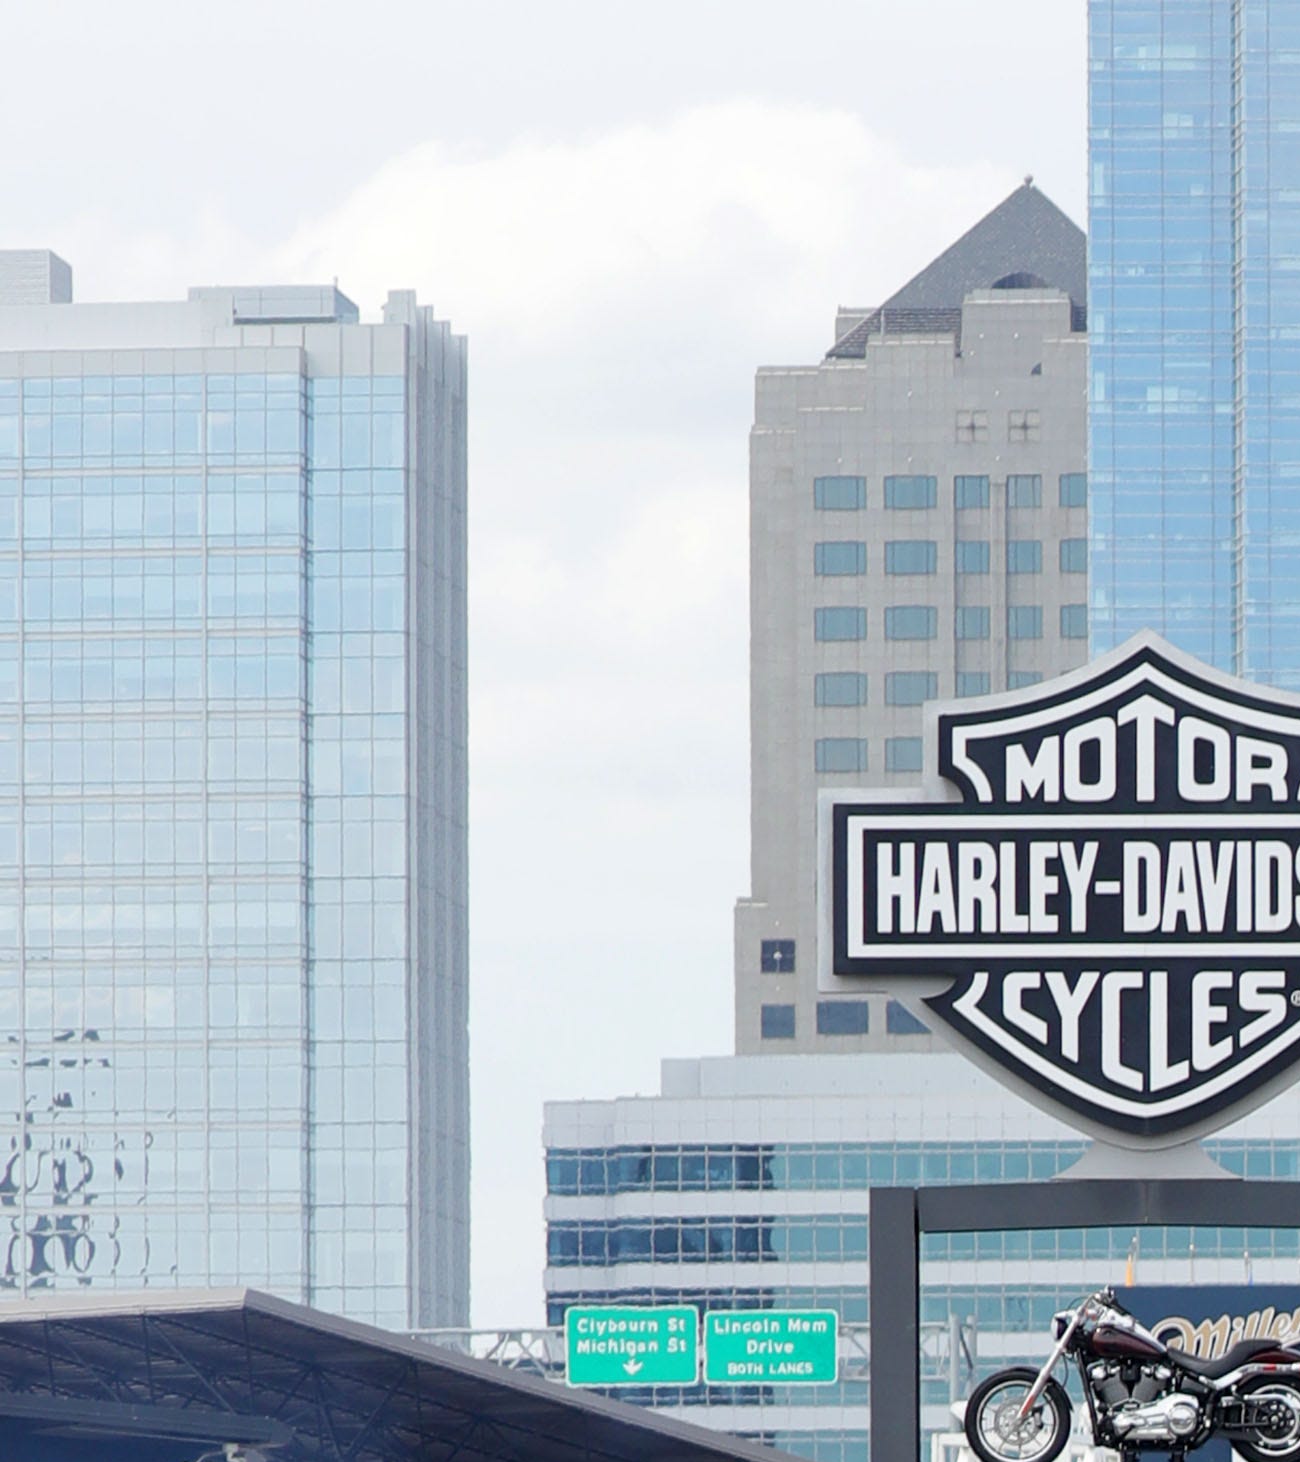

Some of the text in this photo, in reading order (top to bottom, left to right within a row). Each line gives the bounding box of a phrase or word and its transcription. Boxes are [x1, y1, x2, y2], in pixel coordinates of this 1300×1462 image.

[1006, 694, 1288, 801] MOTOR
[1002, 970, 1287, 1092] CYCLES
[577, 1317, 686, 1336] Clybourn St
[713, 1318, 828, 1335] Lincoln Mem
[577, 1337, 687, 1356] Michigan St
[747, 1340, 795, 1354] Drive
[727, 1361, 814, 1375] BOTH LANES
